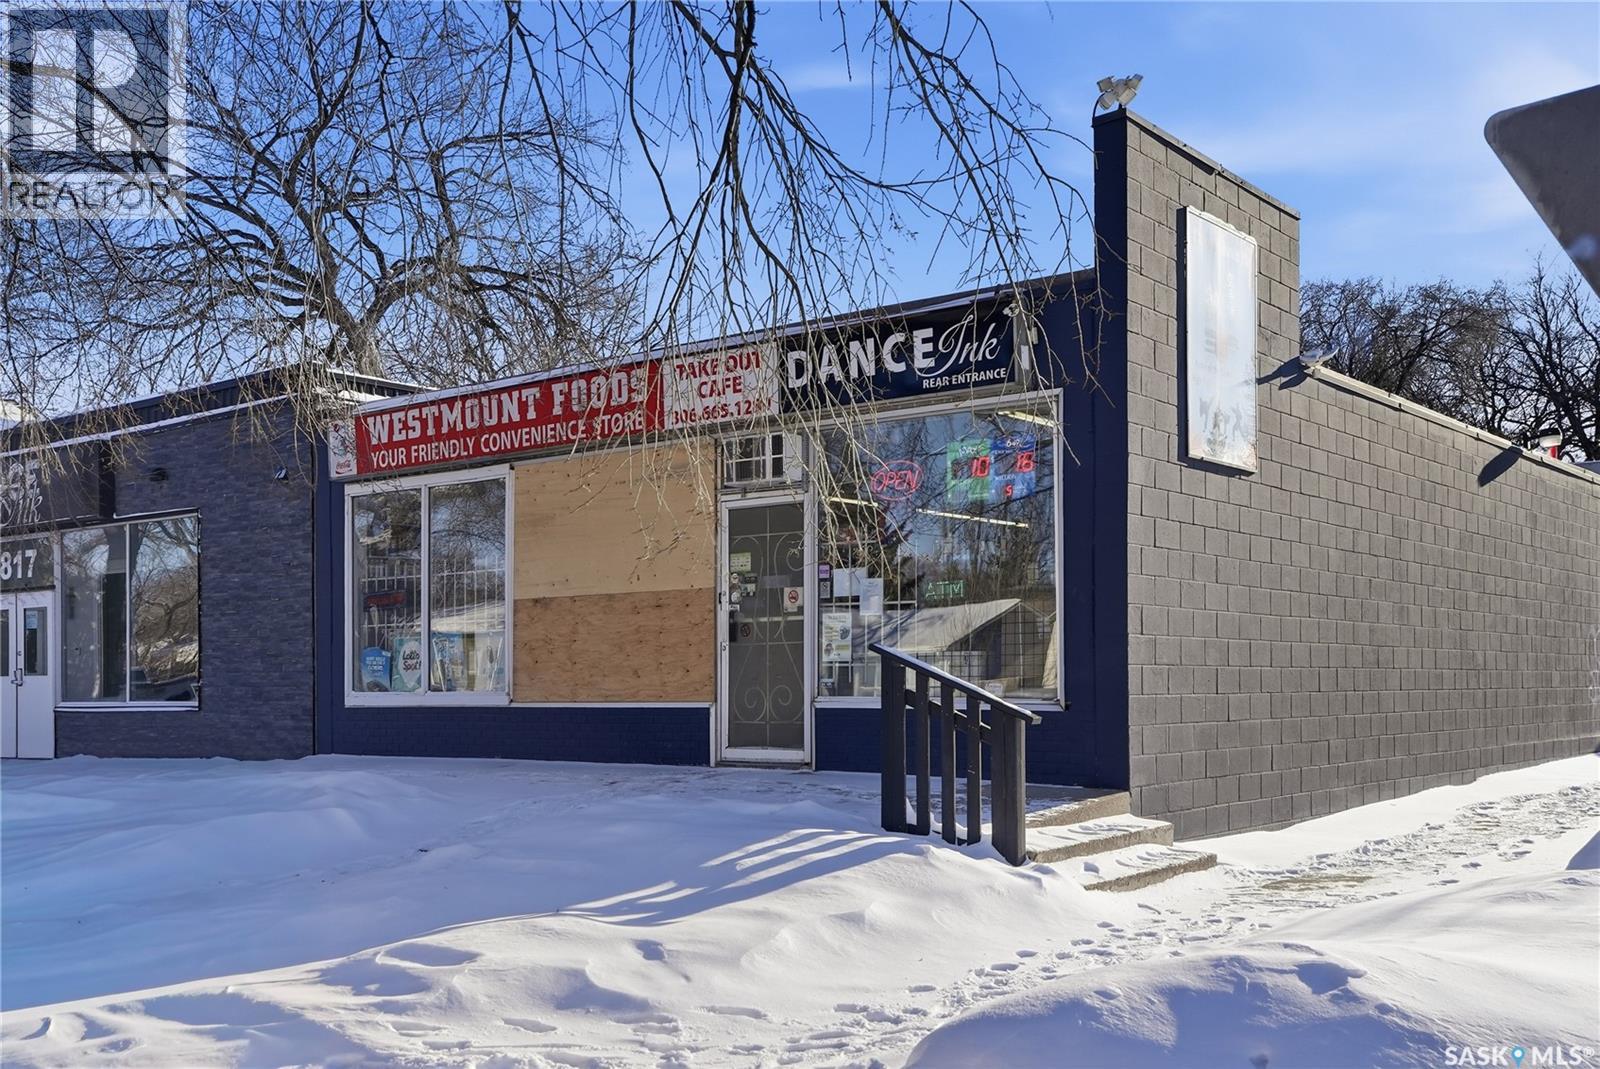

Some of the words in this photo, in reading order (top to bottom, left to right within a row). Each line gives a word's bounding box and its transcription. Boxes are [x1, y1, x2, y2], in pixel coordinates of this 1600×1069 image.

[787, 327, 935, 389] DANCE
[914, 315, 1000, 377] Ink
[675, 358, 719, 381] TAKE
[724, 351, 761, 373] OUT
[922, 376, 950, 390] REAR
[952, 367, 1007, 385] ENTRANCE
[697, 376, 742, 399] CAFE
[367, 386, 540, 446] WESTMOUNT
[551, 368, 646, 416] FOODS
[371, 449, 407, 469] YOUR
[411, 436, 475, 464] FRIENDLY
[480, 418, 587, 453] CONVENIENCE
[873, 470, 920, 491] OPEN
[926, 580, 964, 600] ATM
